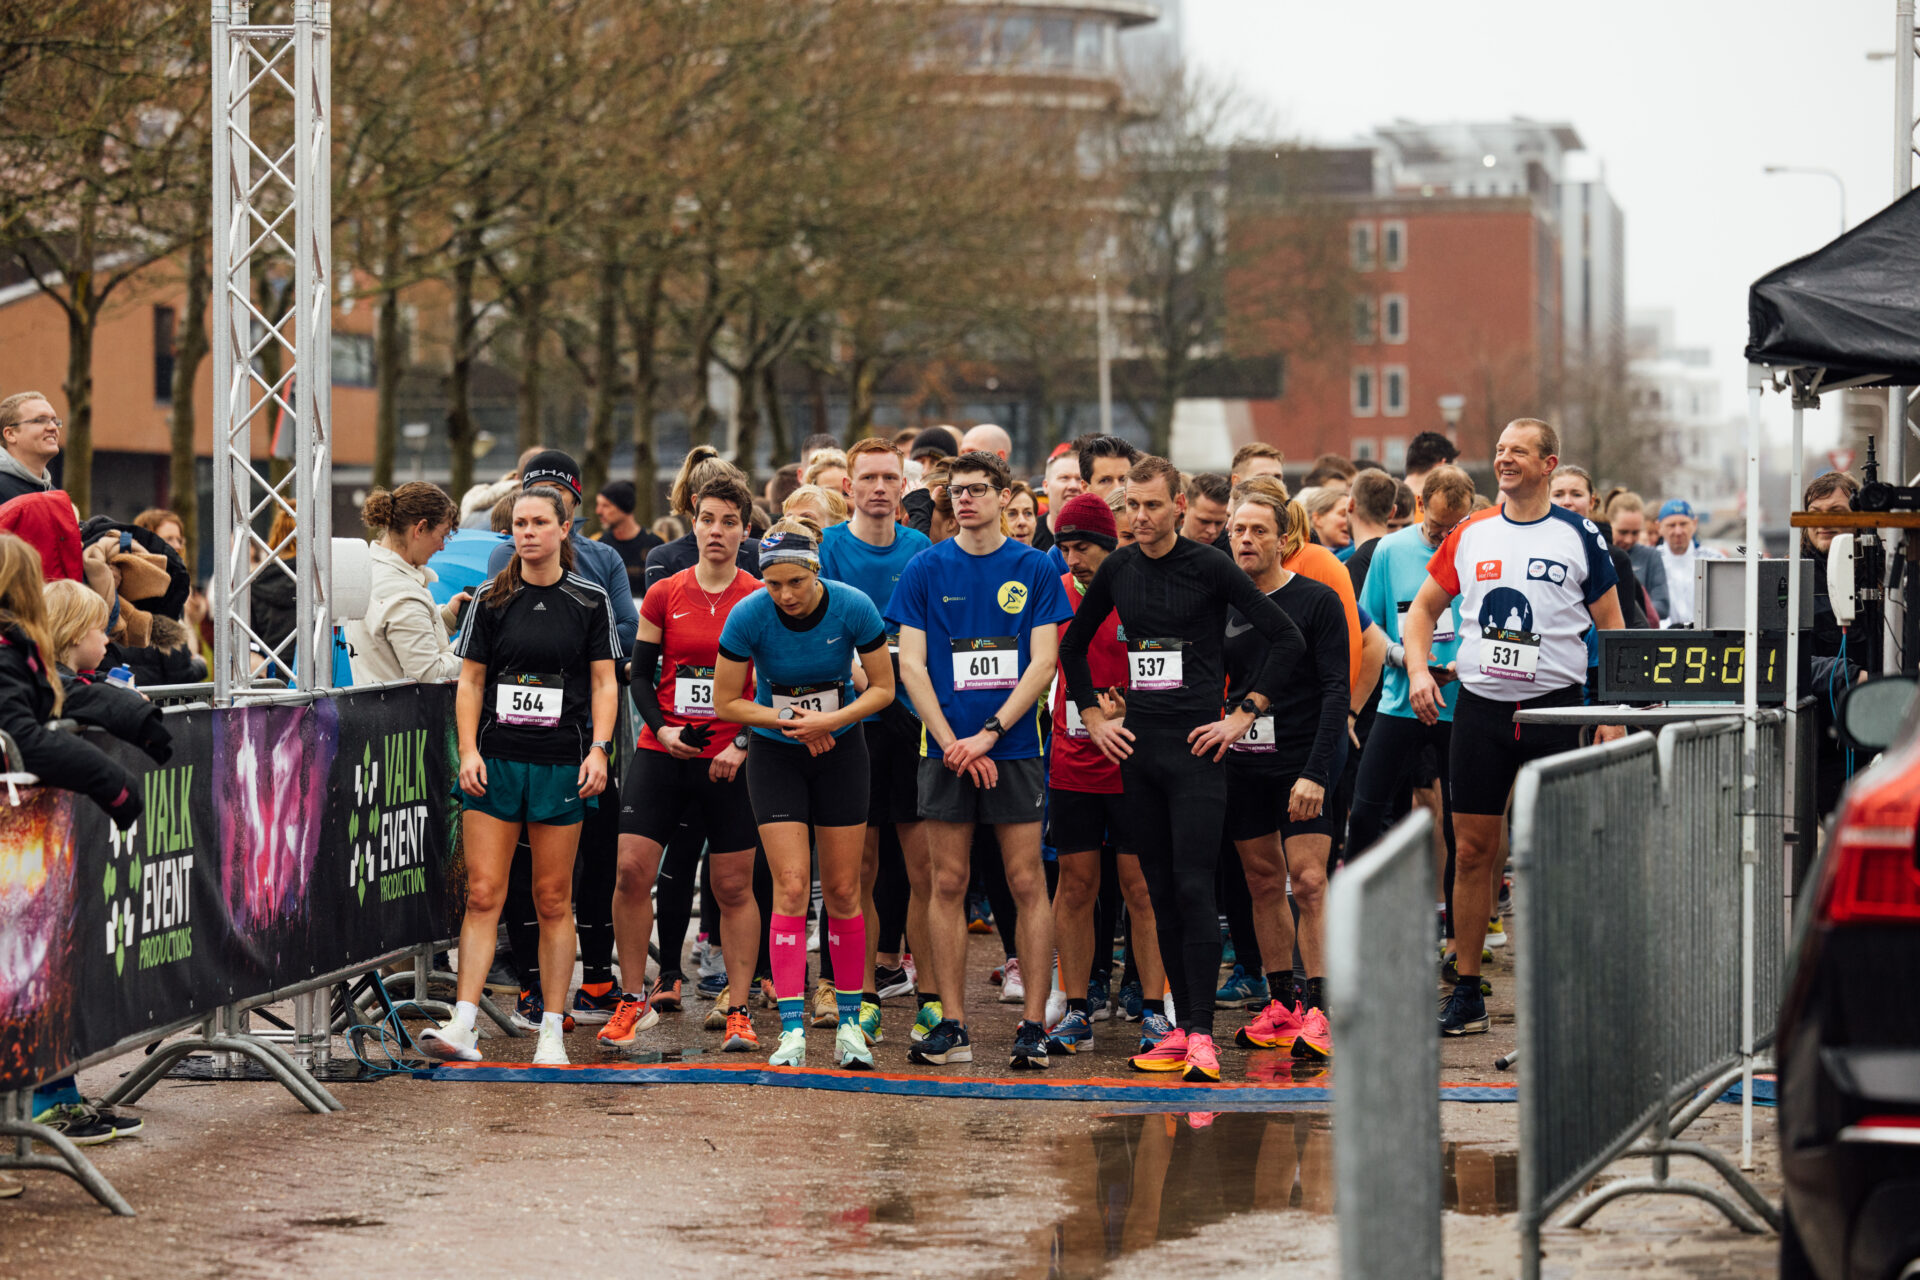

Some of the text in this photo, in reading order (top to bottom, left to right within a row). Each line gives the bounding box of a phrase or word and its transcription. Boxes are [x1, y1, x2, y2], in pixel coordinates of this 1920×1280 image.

[970, 656, 999, 676] 601
[1138, 657, 1165, 677] 537
[1493, 646, 1520, 667] 531
[512, 691, 544, 712] 564
[384, 729, 428, 807] VALK
[143, 764, 194, 857] VALK
[380, 806, 429, 872] EVENT
[141, 854, 194, 938] EVENT
[138, 927, 193, 971] PRODUCTIONS
